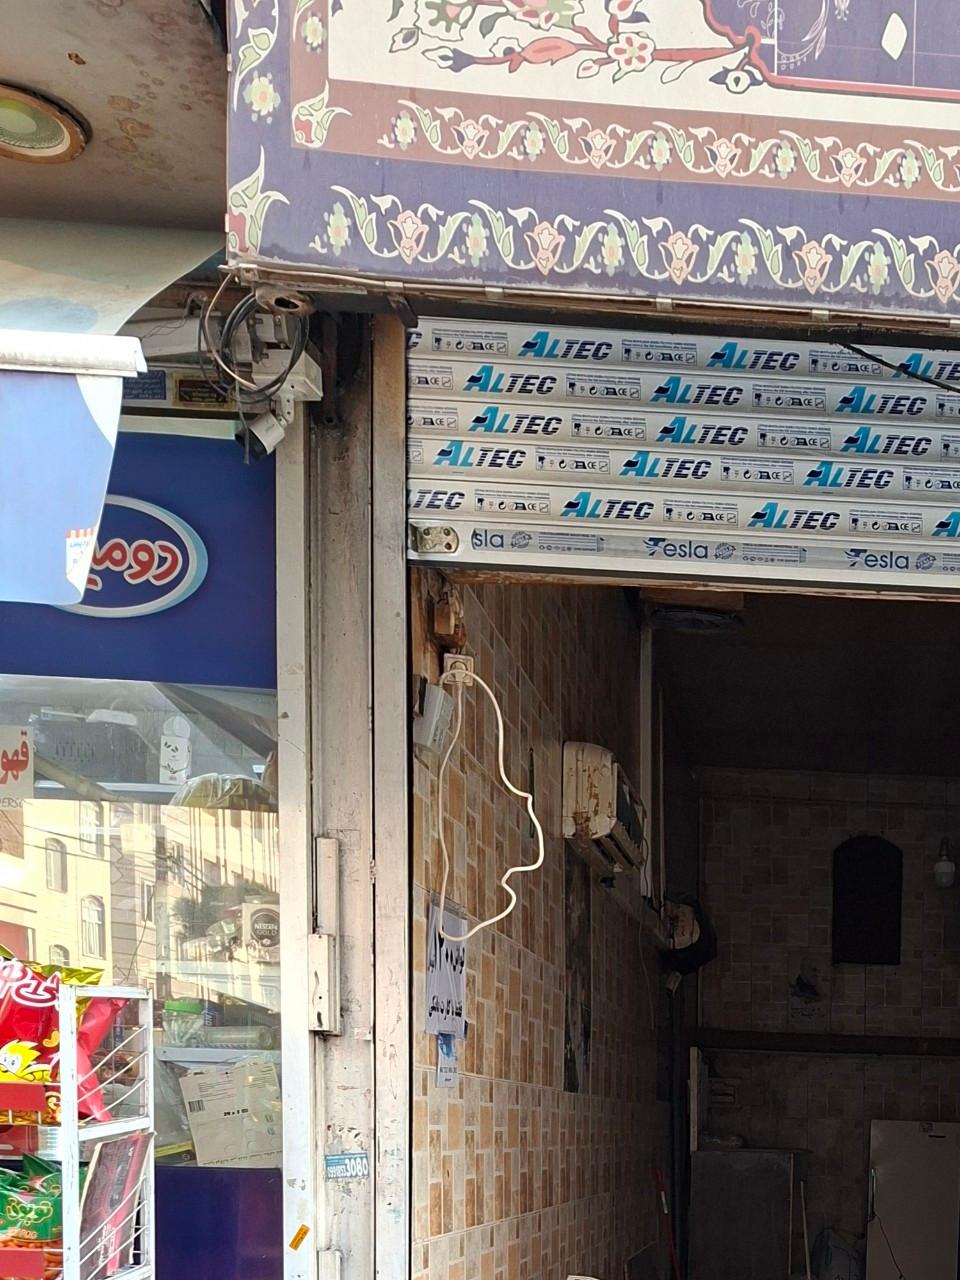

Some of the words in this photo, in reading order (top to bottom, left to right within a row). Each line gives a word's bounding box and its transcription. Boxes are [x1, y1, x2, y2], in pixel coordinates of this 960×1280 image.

[518, 331, 612, 360] ALTEC
[705, 341, 798, 370] ALTEC
[463, 365, 557, 394] ALTEC
[651, 375, 744, 404] ALTEC
[834, 386, 925, 415] ALTEC
[468, 406, 562, 435] ALTEC
[654, 415, 747, 444] ALTEC
[434, 440, 529, 469] ALTEC
[838, 426, 929, 455] ALTEC
[619, 450, 712, 479] ALTEC
[800, 460, 892, 489] ALTEC
[560, 491, 654, 520] ALTEC
[747, 502, 839, 531] ALTEC
[642, 537, 709, 559] Tesla
[844, 548, 910, 571] Tesla
